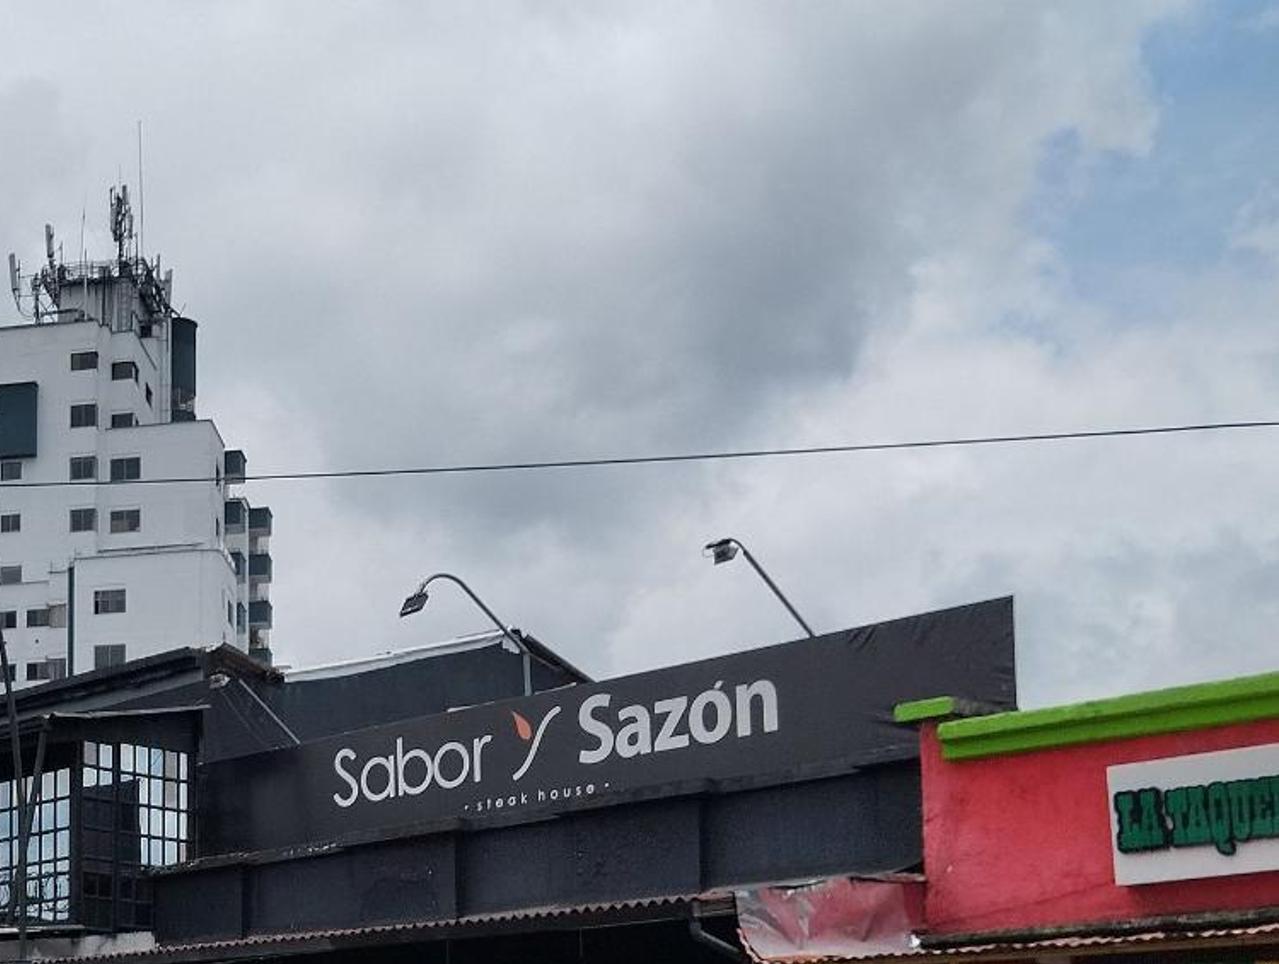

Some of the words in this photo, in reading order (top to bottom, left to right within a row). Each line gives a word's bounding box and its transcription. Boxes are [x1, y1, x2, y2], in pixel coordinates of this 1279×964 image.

[332, 734, 494, 808] Sabor
[578, 679, 780, 765] Sazón
[476, 792, 528, 812] steak
[537, 783, 596, 803] house
[1114, 786, 1169, 855] LA
[1164, 774, 1279, 856] TAQUE
